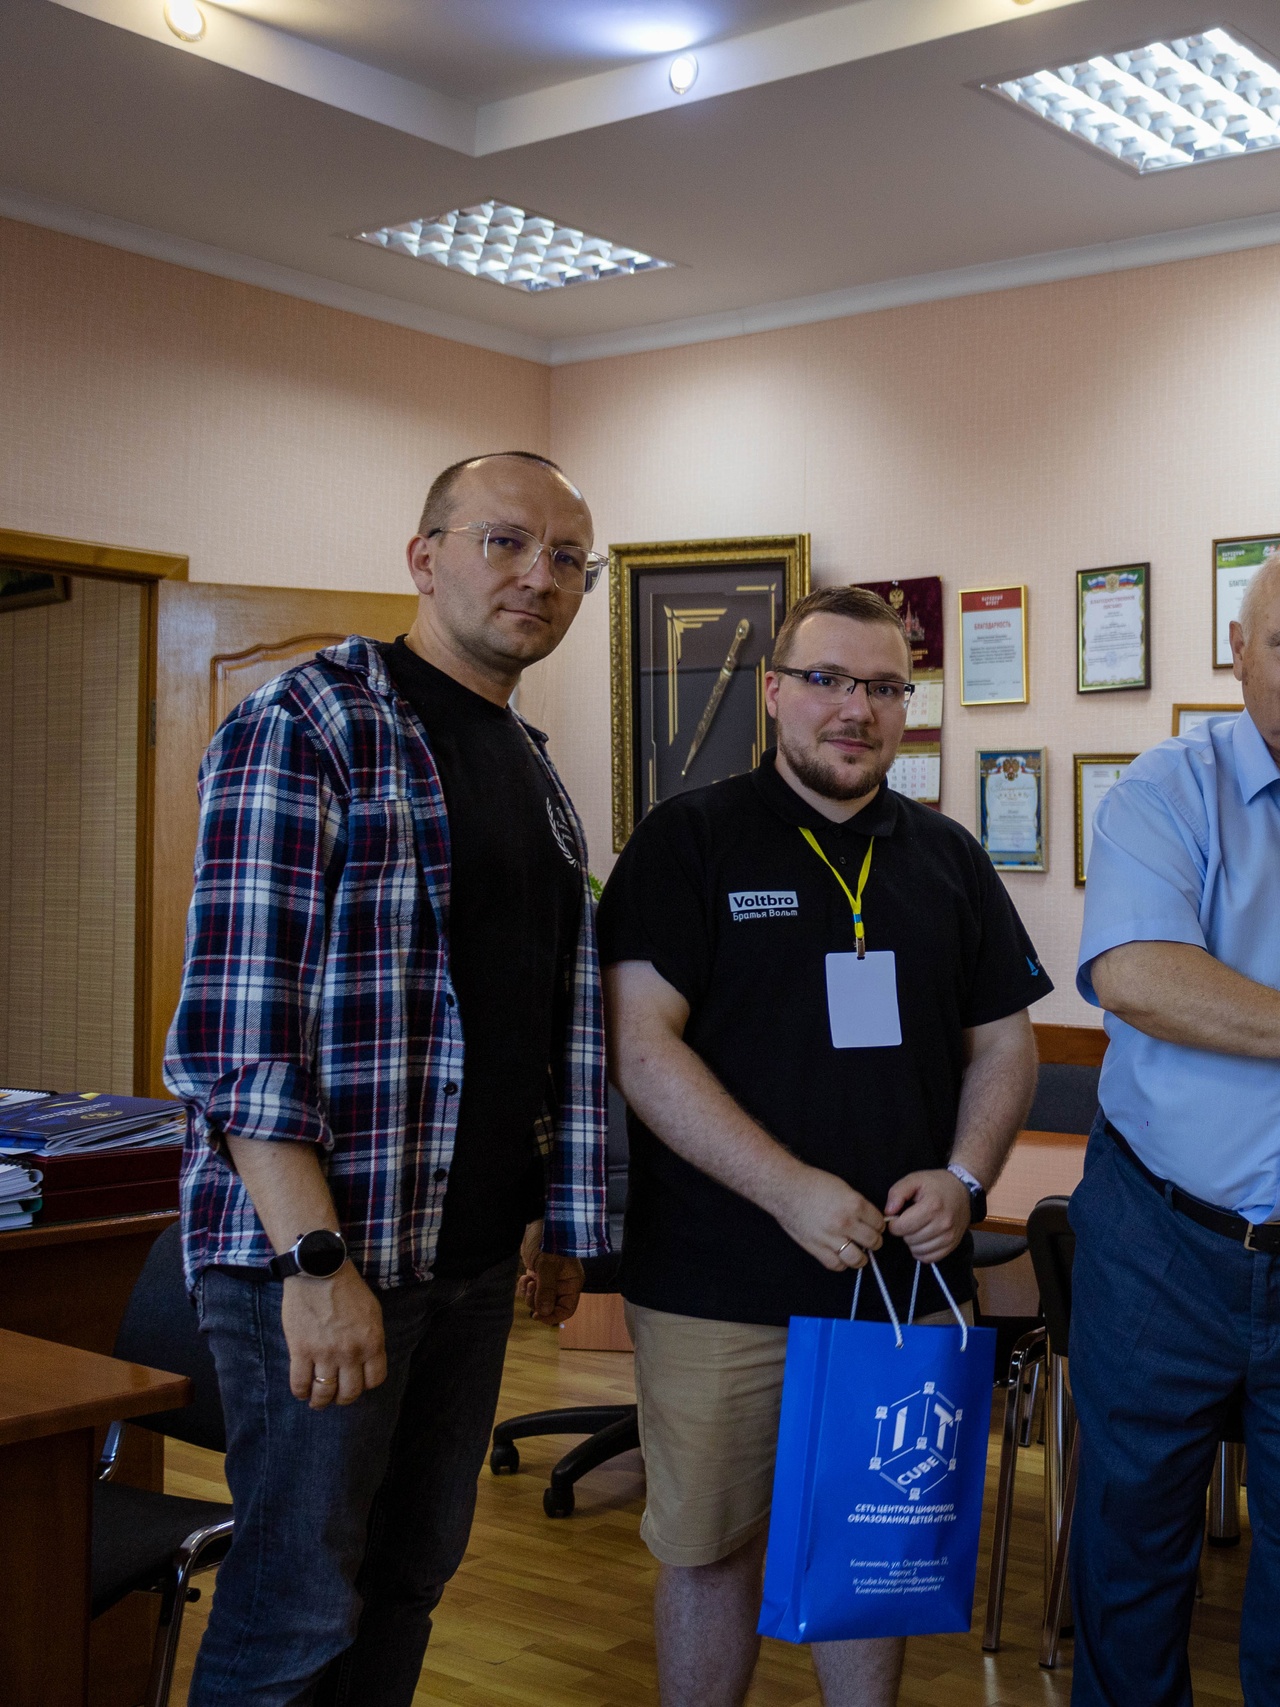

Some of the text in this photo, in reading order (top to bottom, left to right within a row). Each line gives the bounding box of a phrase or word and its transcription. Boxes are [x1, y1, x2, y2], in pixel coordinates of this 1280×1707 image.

[733, 894, 794, 908] Voltbro
[732, 908, 798, 922] Братья Вольт
[897, 1455, 940, 1486] CUBE
[854, 1503, 877, 1513] СЕТЬ
[876, 1504, 915, 1514] ЦЕНТРОВ
[847, 1513, 910, 1524] ОБРАЗОВАНИЯ
[909, 1514, 934, 1525] ДЕТЕЙ
